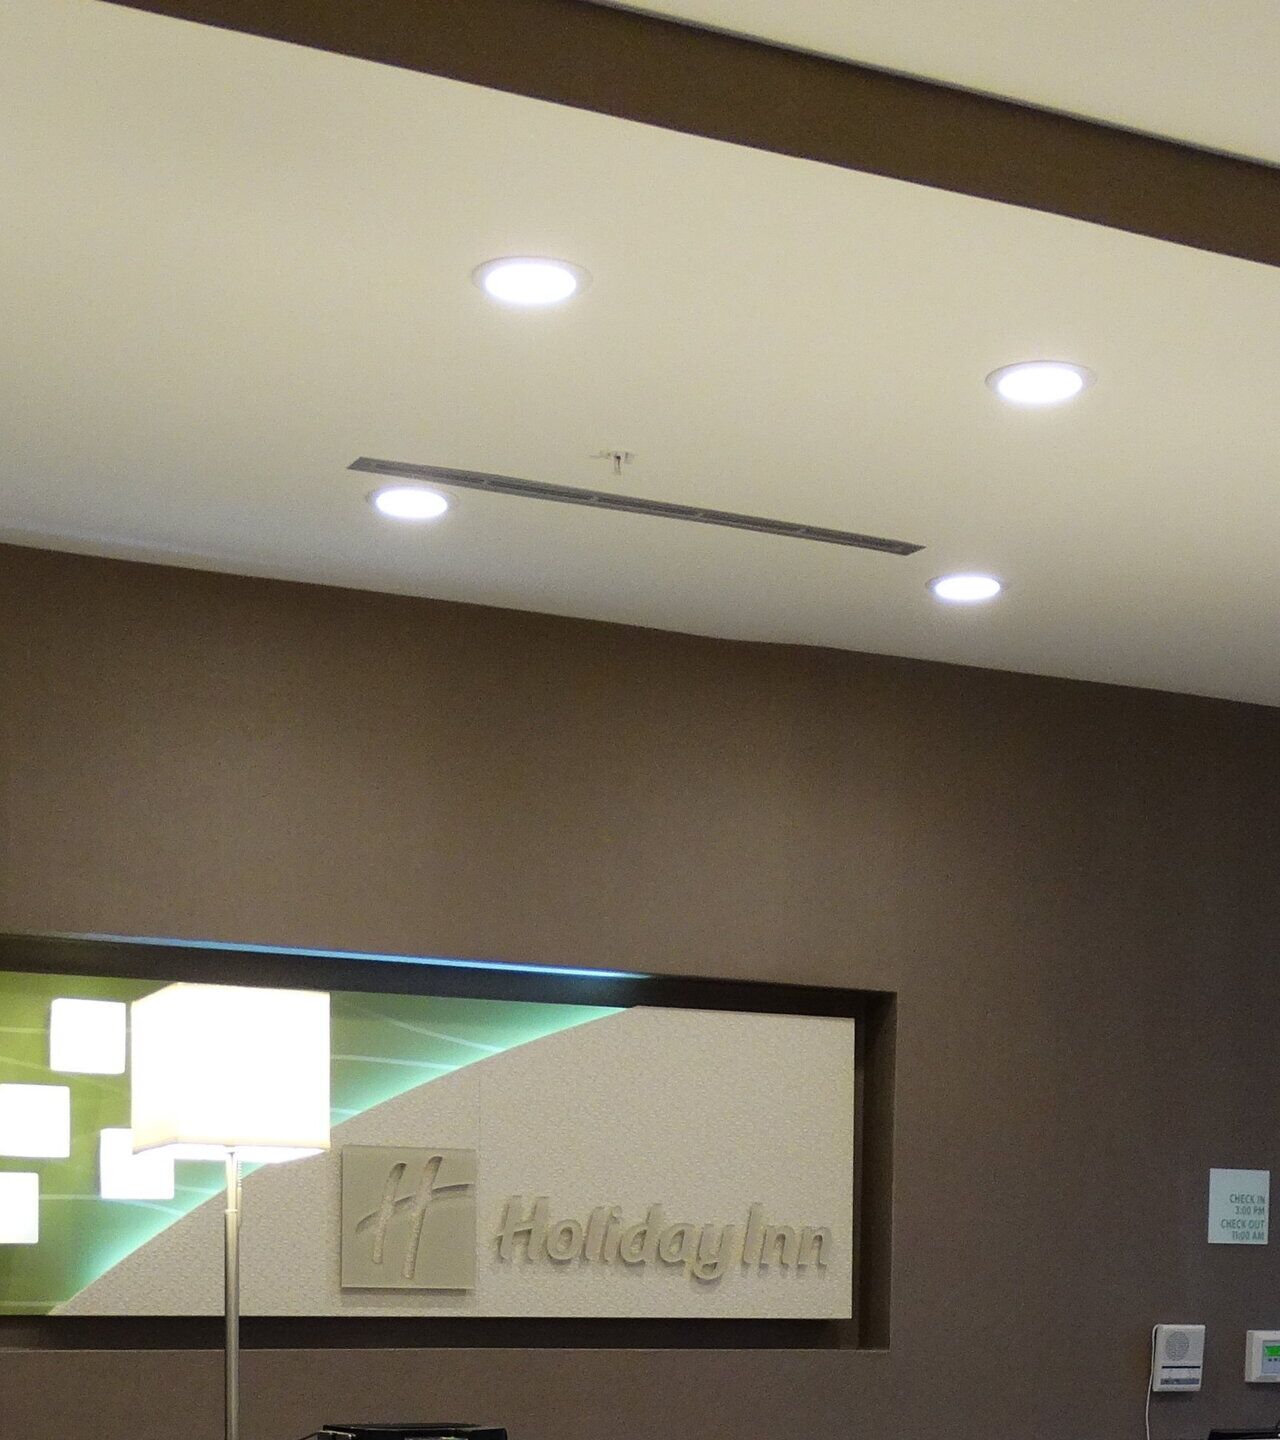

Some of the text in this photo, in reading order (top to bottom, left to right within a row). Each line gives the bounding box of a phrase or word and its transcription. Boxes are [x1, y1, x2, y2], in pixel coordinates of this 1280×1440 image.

[1229, 1193, 1265, 1204] CHECK IN
[1235, 1205, 1265, 1216] 3:00 PM
[1220, 1218, 1265, 1230] CHECK OUT
[494, 1194, 834, 1284] Holiday Inn
[1232, 1230, 1265, 1241] 11:00 AM
